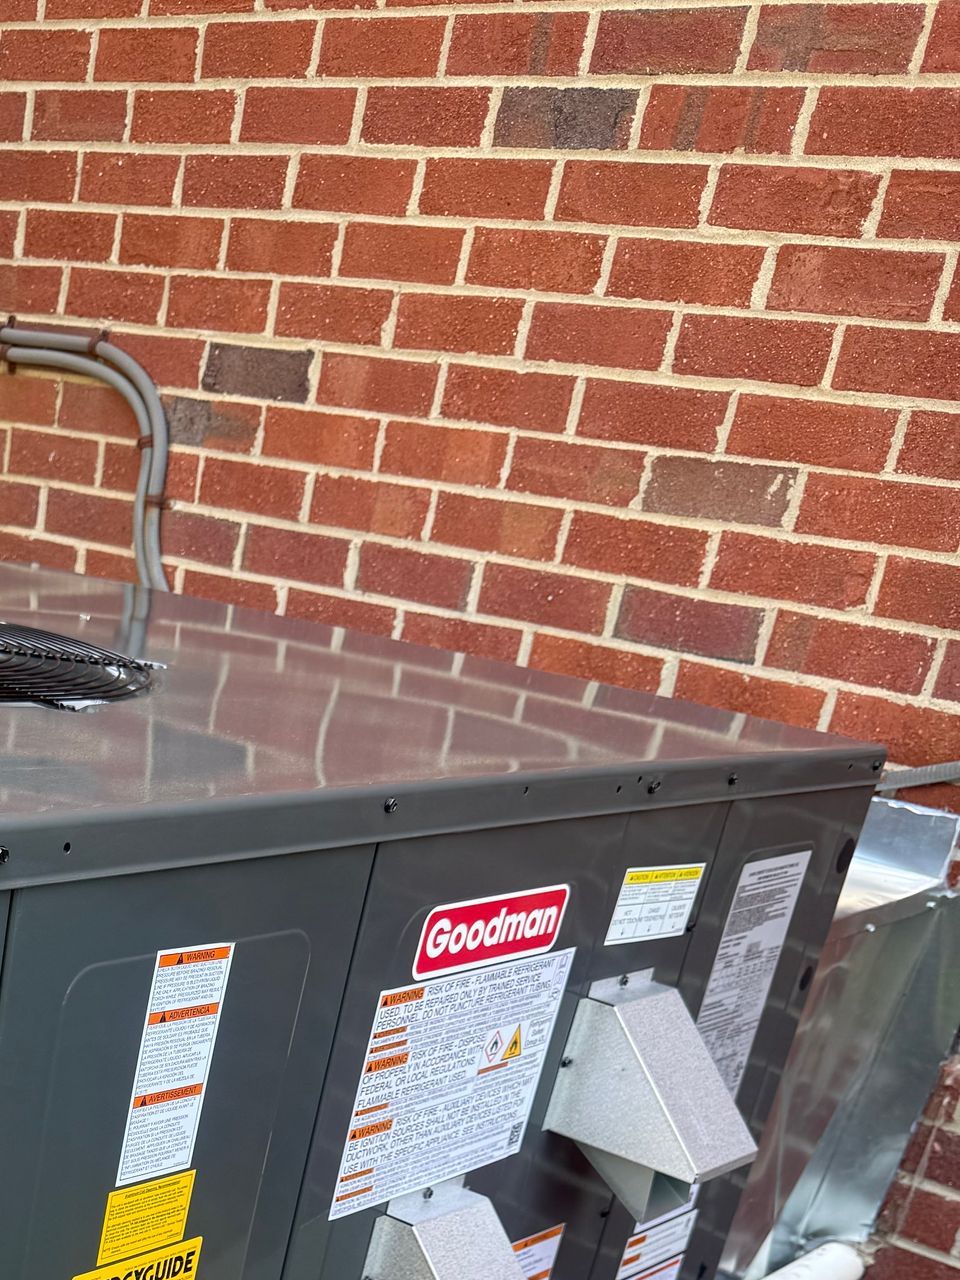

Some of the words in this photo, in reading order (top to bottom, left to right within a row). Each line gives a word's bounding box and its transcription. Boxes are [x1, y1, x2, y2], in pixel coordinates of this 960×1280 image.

[426, 905, 558, 958] Goodman
[186, 950, 215, 961] WARNING
[389, 989, 424, 1005] WARNING
[427, 984, 443, 996] RISK
[444, 982, 454, 992] OF
[456, 978, 470, 989] FIRE
[475, 968, 512, 984] FLAMMABLE
[512, 958, 554, 975] REFRIGERANT
[403, 1004, 413, 1013] TO
[414, 1001, 424, 1010] BE
[425, 993, 458, 1008] REPAIRED
[459, 988, 477, 999] ONLY
[478, 986, 487, 995] BY
[488, 980, 513, 992] TRAINED
[515, 973, 541, 986] SERVICE
[168, 1006, 210, 1019] ADVERTENCIA
[422, 1009, 432, 1018] DO
[434, 1005, 448, 1016] NOT
[449, 996, 484, 1012] PUNCTURE
[485, 986, 527, 1003] REFRIGERANT
[362, 1074, 374, 1084] OF
[374, 1064, 411, 1081] PROPERLY
[413, 1061, 420, 1070] IN
[421, 1049, 465, 1068] ACCORDANCE
[373, 1054, 408, 1071] WARNING
[410, 1049, 427, 1061] RISK
[428, 1046, 438, 1056] OF
[440, 1042, 453, 1053] FIRE
[458, 1033, 486, 1048] DISPOSE
[148, 1086, 196, 1103] AVERTISSEMENT
[357, 1090, 398, 1108] FLAMMABLE
[400, 1076, 447, 1096] REFRIGERANT
[360, 1080, 393, 1096] FEDERAL
[395, 1076, 406, 1086] OR
[406, 1070, 428, 1083] LOCAL
[358, 1120, 392, 1138] WARNING
[395, 1114, 411, 1126] RISK
[412, 1111, 422, 1120] OF
[423, 1106, 437, 1117] FIRE
